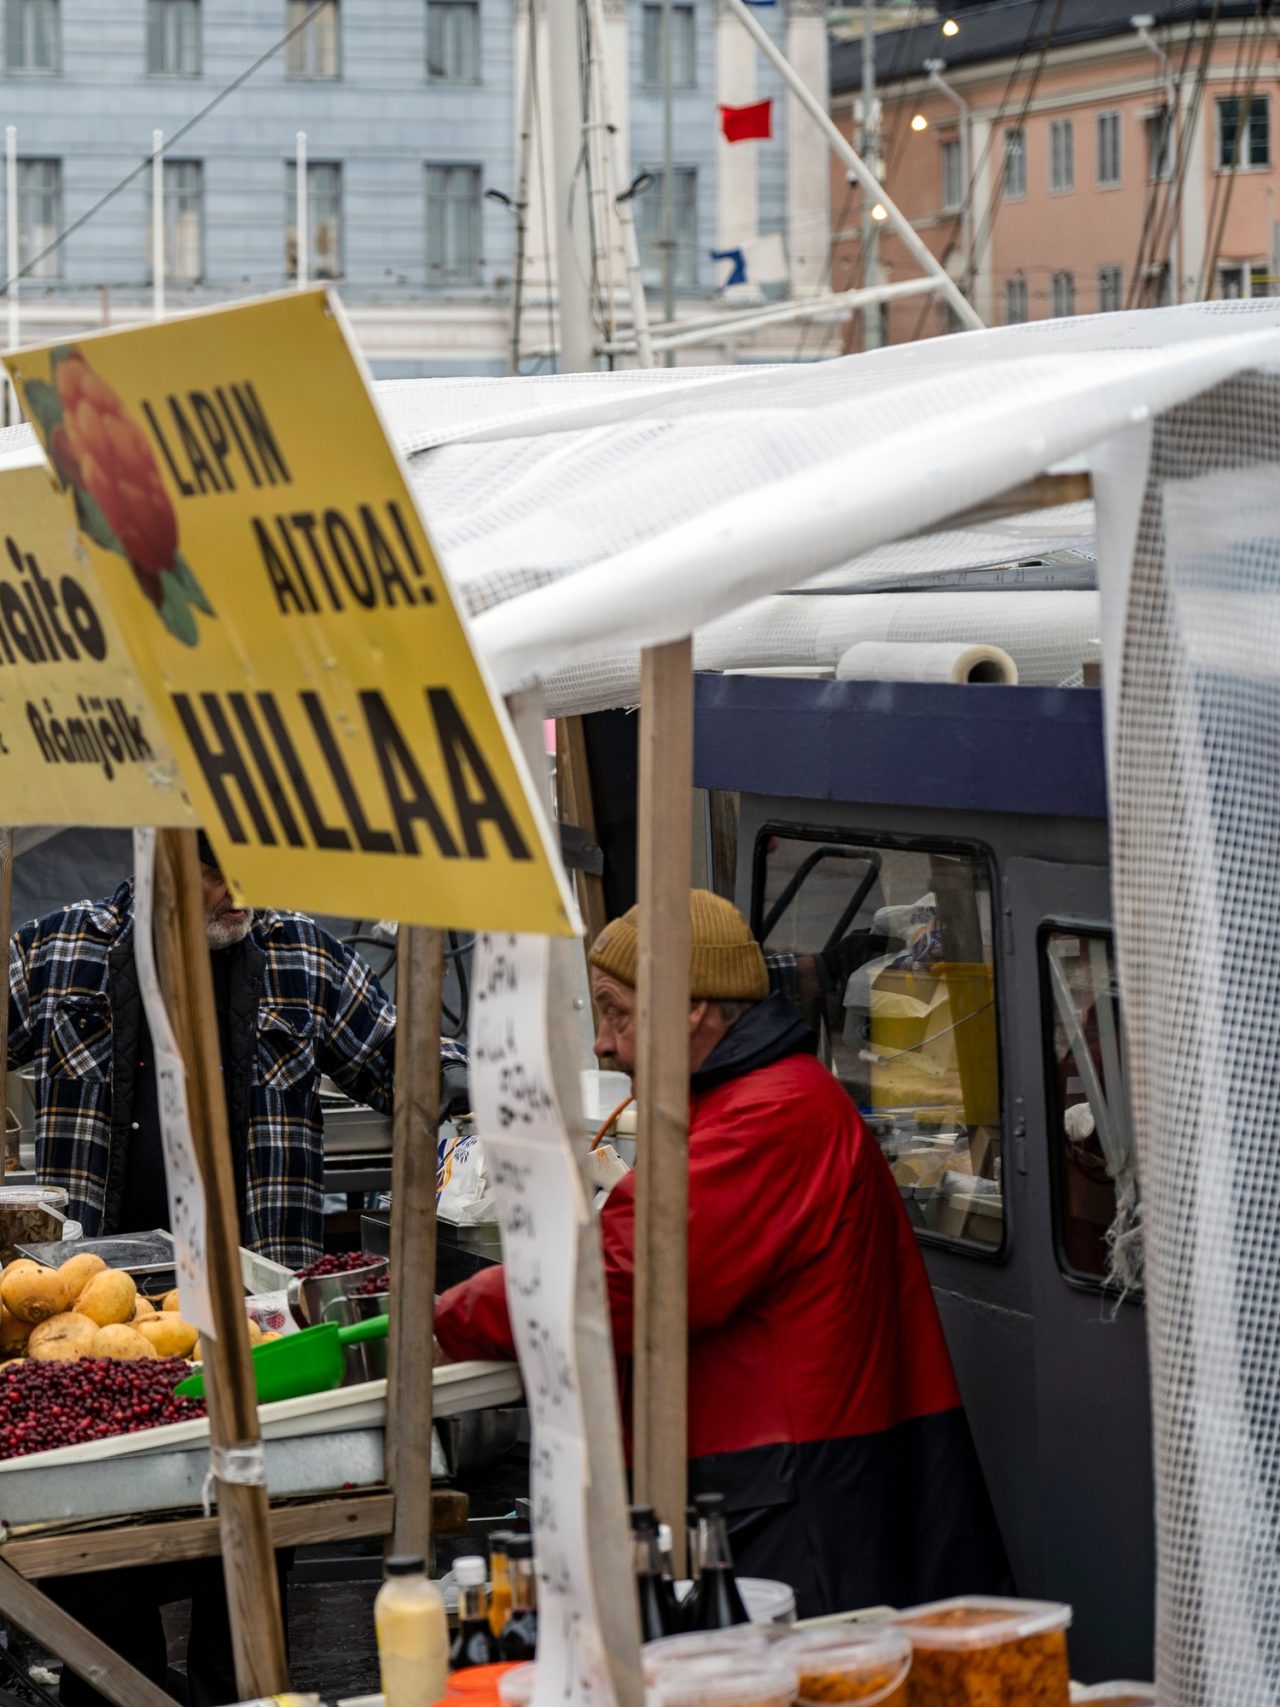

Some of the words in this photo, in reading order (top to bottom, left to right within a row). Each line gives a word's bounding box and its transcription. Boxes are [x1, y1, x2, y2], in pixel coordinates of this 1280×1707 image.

[142, 380, 293, 496] LAPIN
[251, 499, 441, 615] AITOA!
[170, 686, 536, 861] HILLAA
